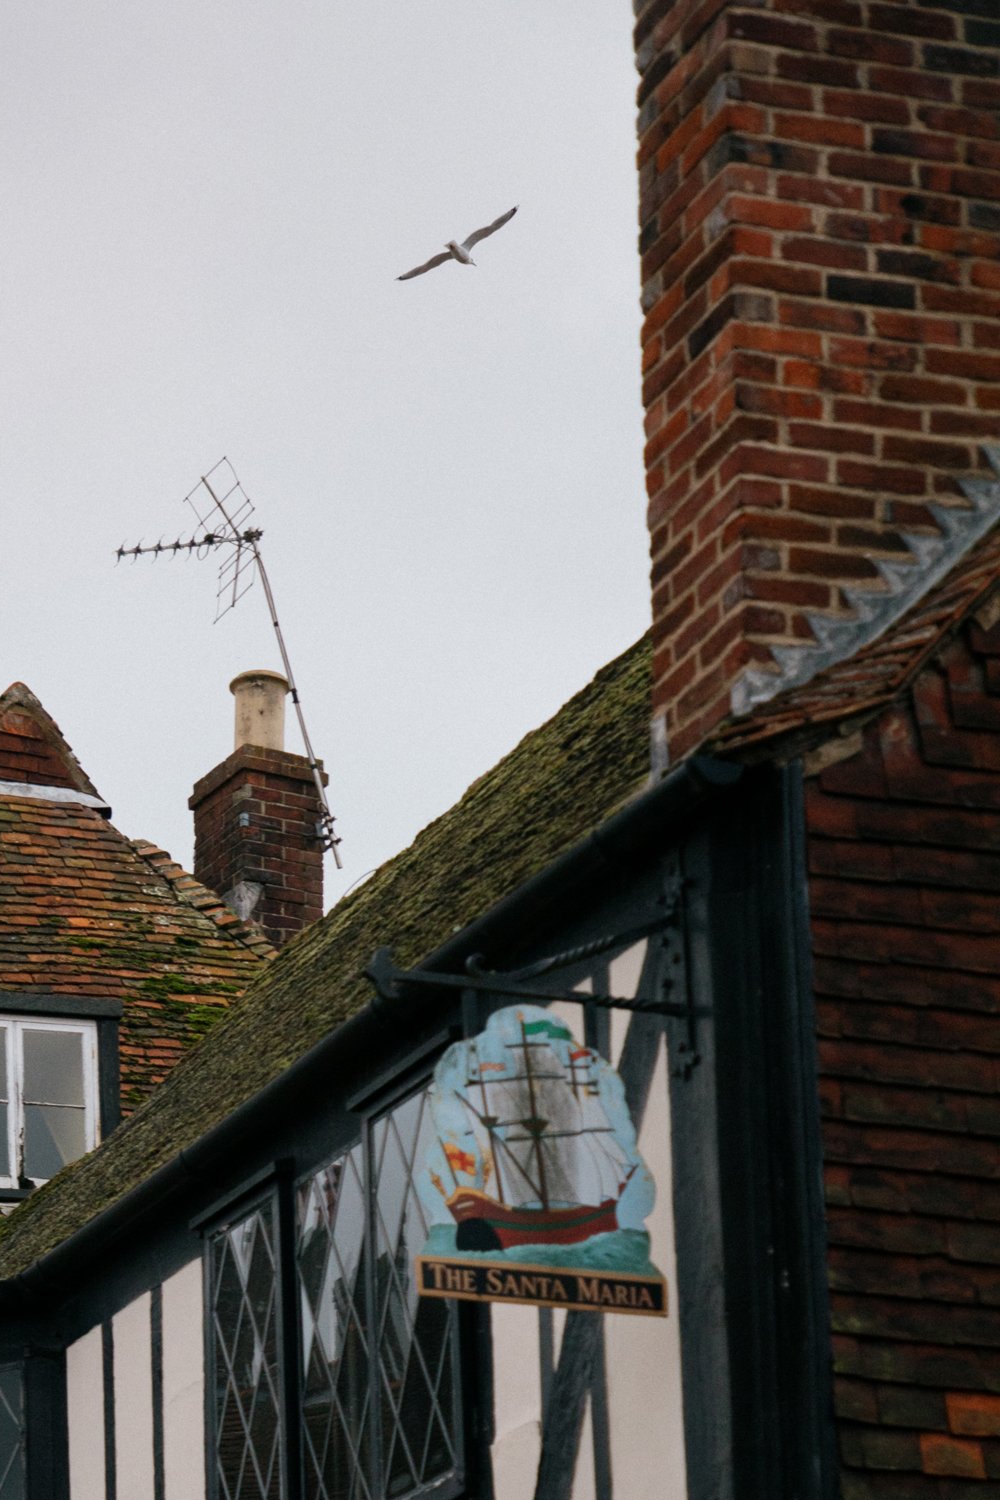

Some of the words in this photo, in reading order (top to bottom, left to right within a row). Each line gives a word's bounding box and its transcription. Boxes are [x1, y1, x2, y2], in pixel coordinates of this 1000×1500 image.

[428, 1263, 477, 1292] THE
[486, 1268, 568, 1299] SANTA
[577, 1278, 655, 1308] MARIA
